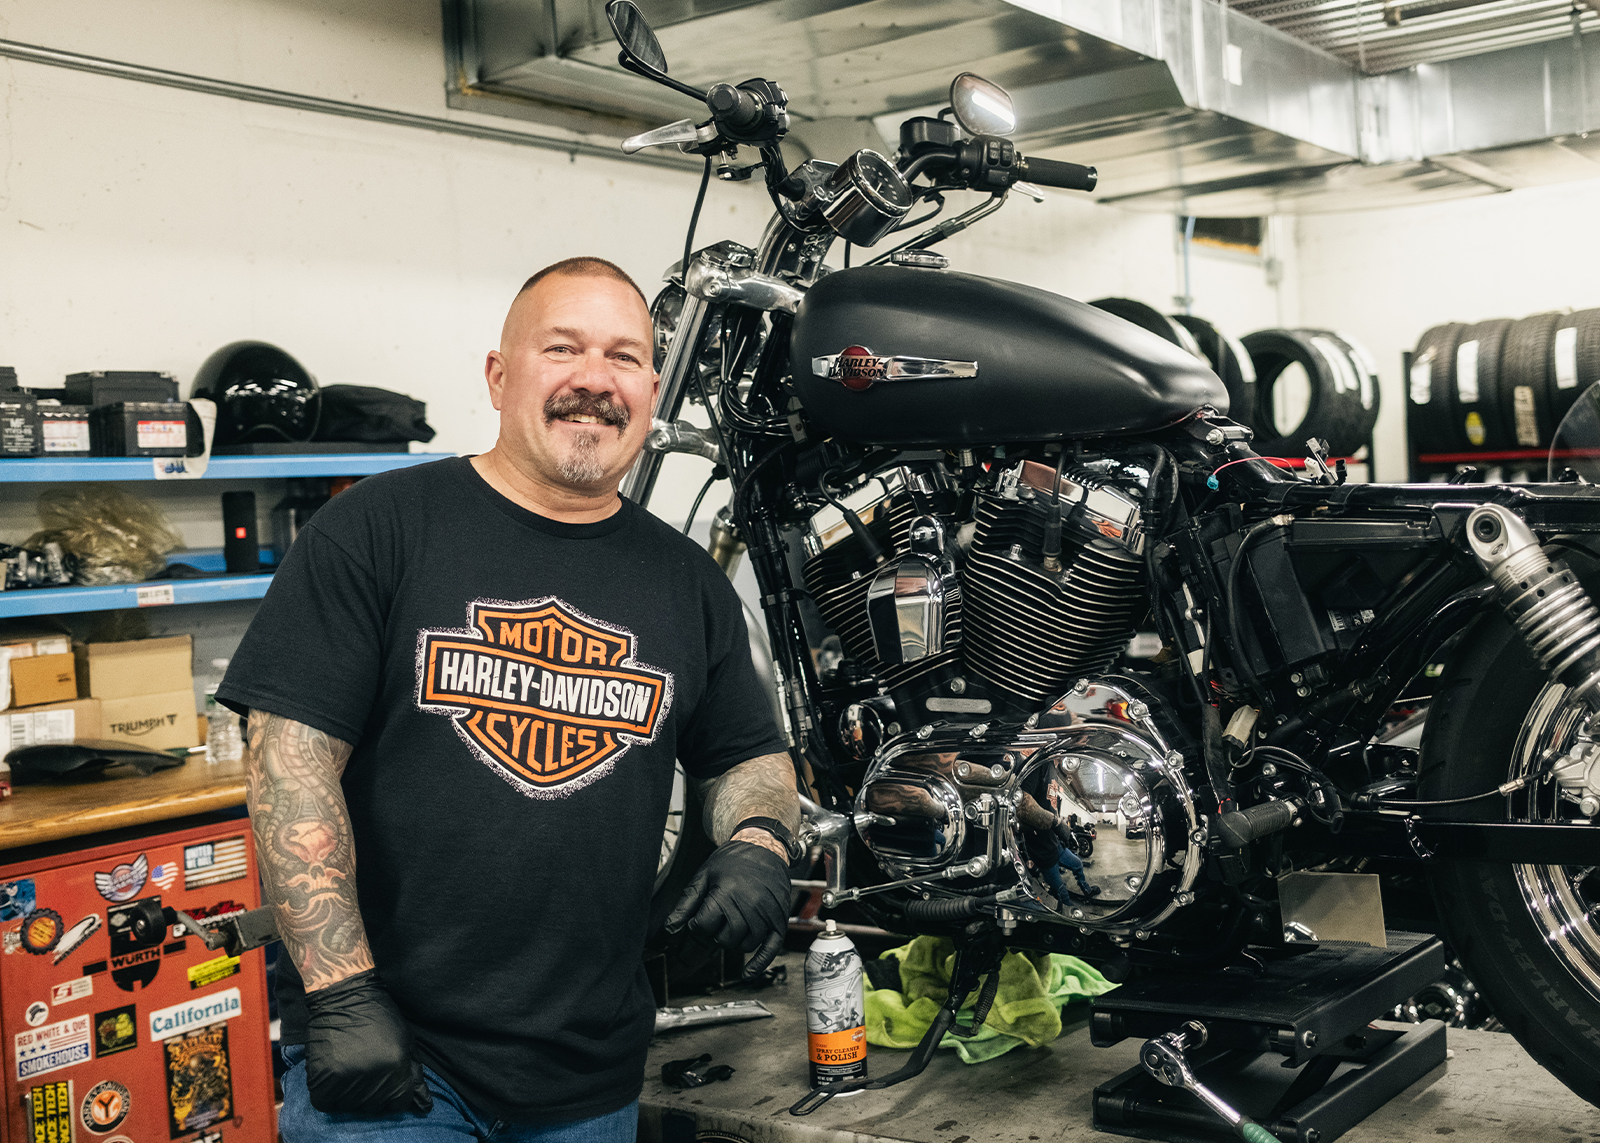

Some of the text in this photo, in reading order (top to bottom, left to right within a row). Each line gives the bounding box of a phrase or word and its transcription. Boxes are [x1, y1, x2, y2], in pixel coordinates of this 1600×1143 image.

[828, 367, 886, 378] DAVIDSON
[834, 357, 884, 368] HARLEY-
[499, 617, 607, 667] MOTOR
[440, 651, 652, 722] HARLEY-DAVIDSON
[110, 717, 164, 734] TRIUMPH
[486, 712, 597, 773] CYCLES
[152, 997, 240, 1033] California
[17, 1034, 34, 1047] RED
[36, 1026, 60, 1041] WHITE
[63, 1024, 70, 1034] &
[21, 1044, 87, 1075] SMOKEHOUSE
[816, 1051, 858, 1062] & POLISH
[834, 1045, 860, 1054] CLEANER
